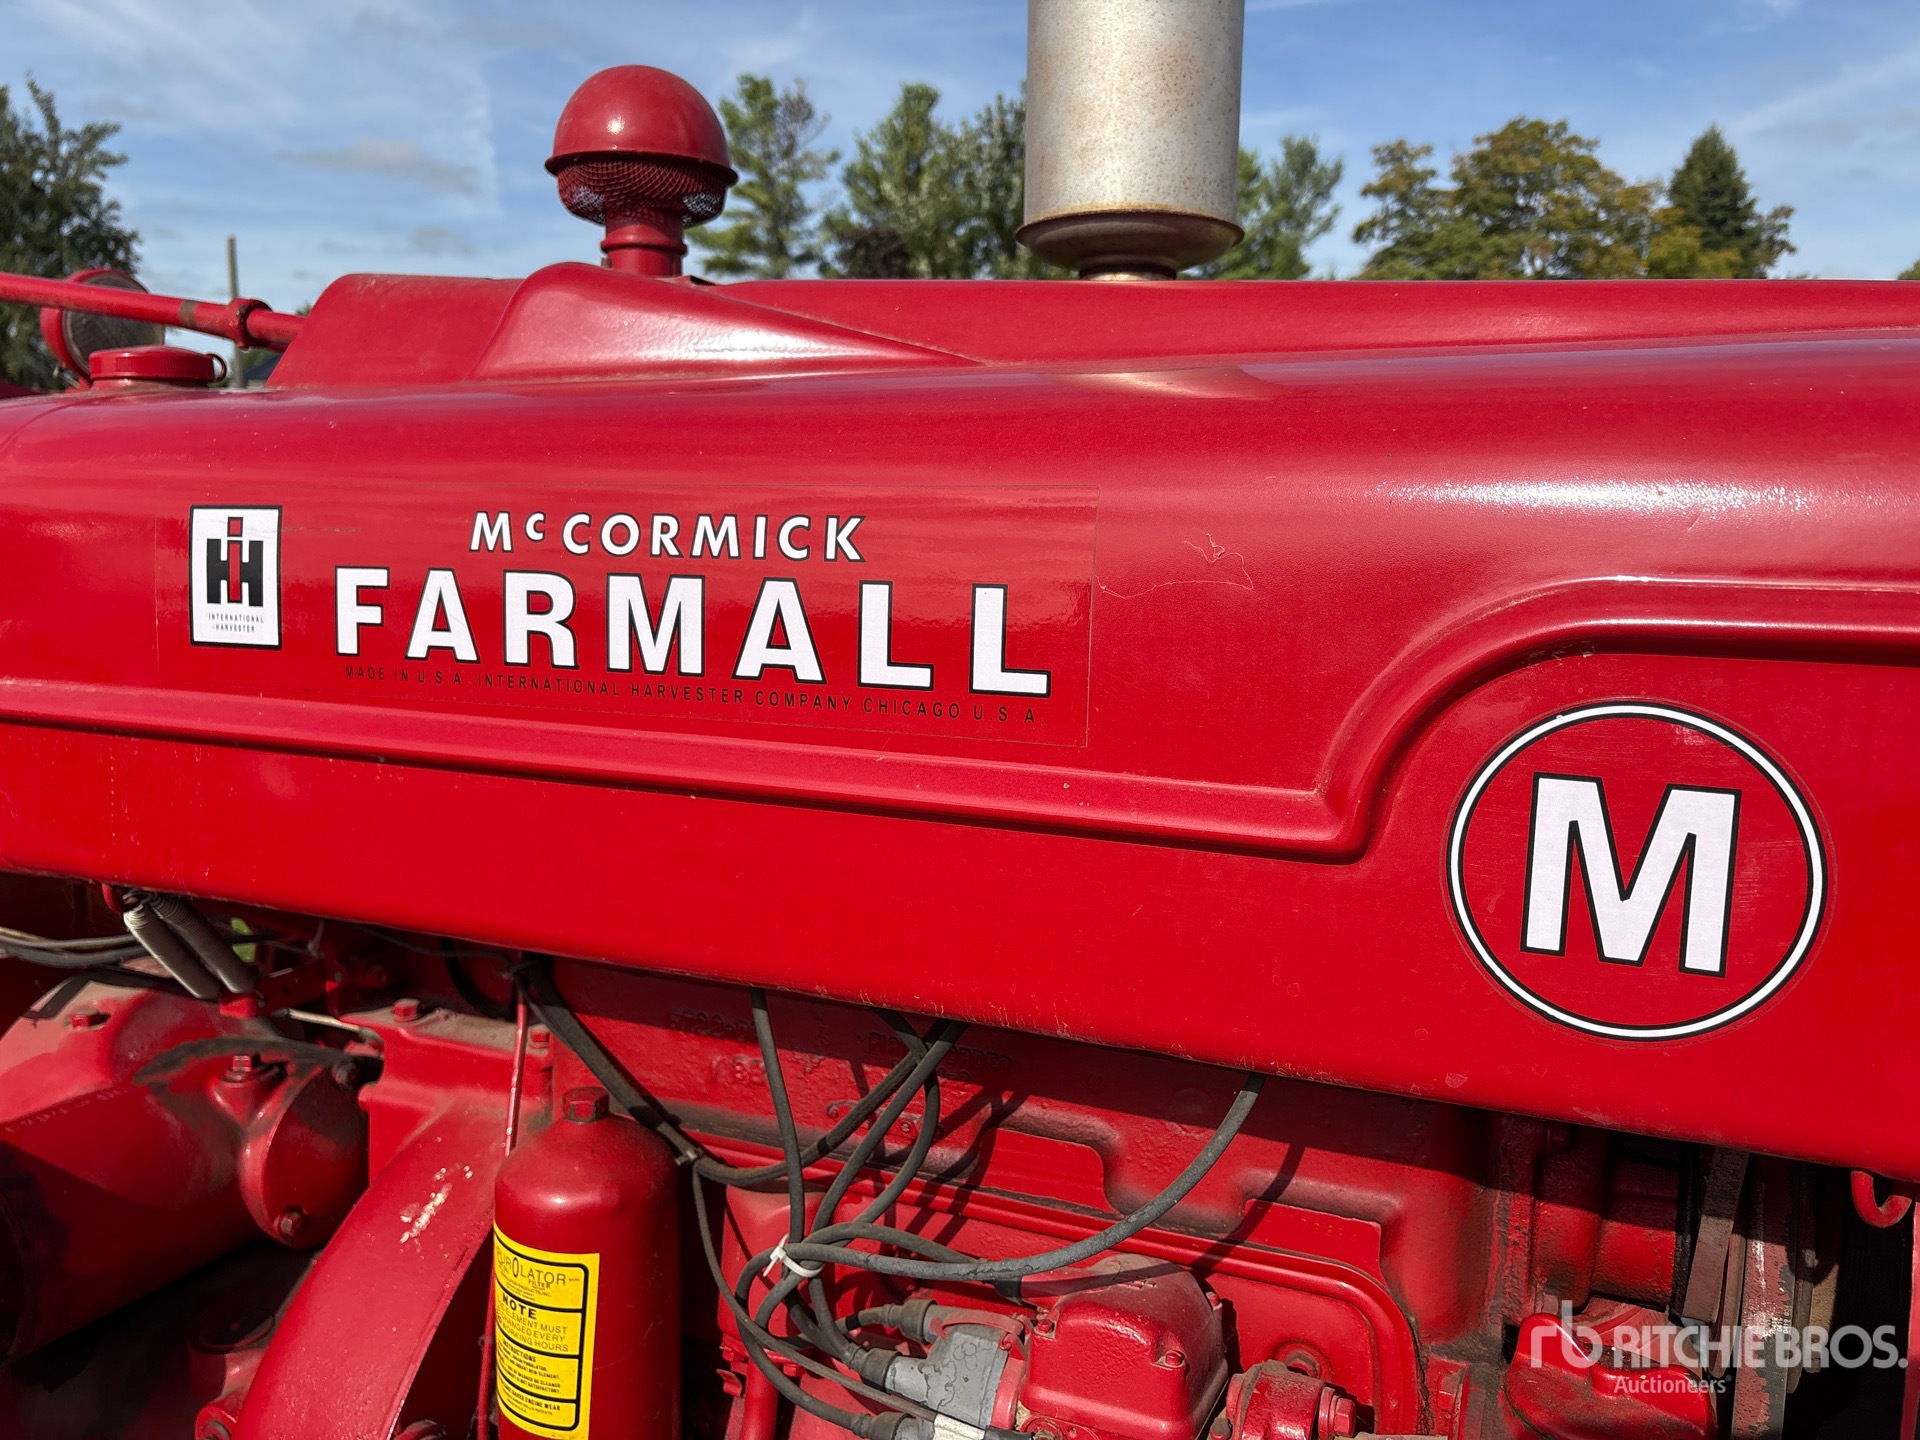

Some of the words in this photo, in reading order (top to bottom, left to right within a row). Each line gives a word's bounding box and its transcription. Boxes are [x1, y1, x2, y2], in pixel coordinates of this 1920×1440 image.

[208, 612, 264, 624] INTERNATIONAL
[215, 624, 255, 633] HARVESTER
[335, 566, 1052, 698] FARMALL
[345, 666, 385, 681] MADE
[394, 669, 408, 683] IN
[478, 673, 619, 696] INTERNATIONAL
[631, 683, 744, 704] HARVESTER
[755, 691, 851, 711] COMPANY
[863, 697, 960, 719] CHICAGO
[1520, 772, 1741, 979] M
[502, 1292, 538, 1320] NOTE
[503, 1324, 533, 1345] WORKING
[534, 1340, 569, 1352] HOURS
[533, 1331, 566, 1344] EVERY
[540, 1323, 568, 1334] MUST
[544, 1403, 561, 1411] WEAR
